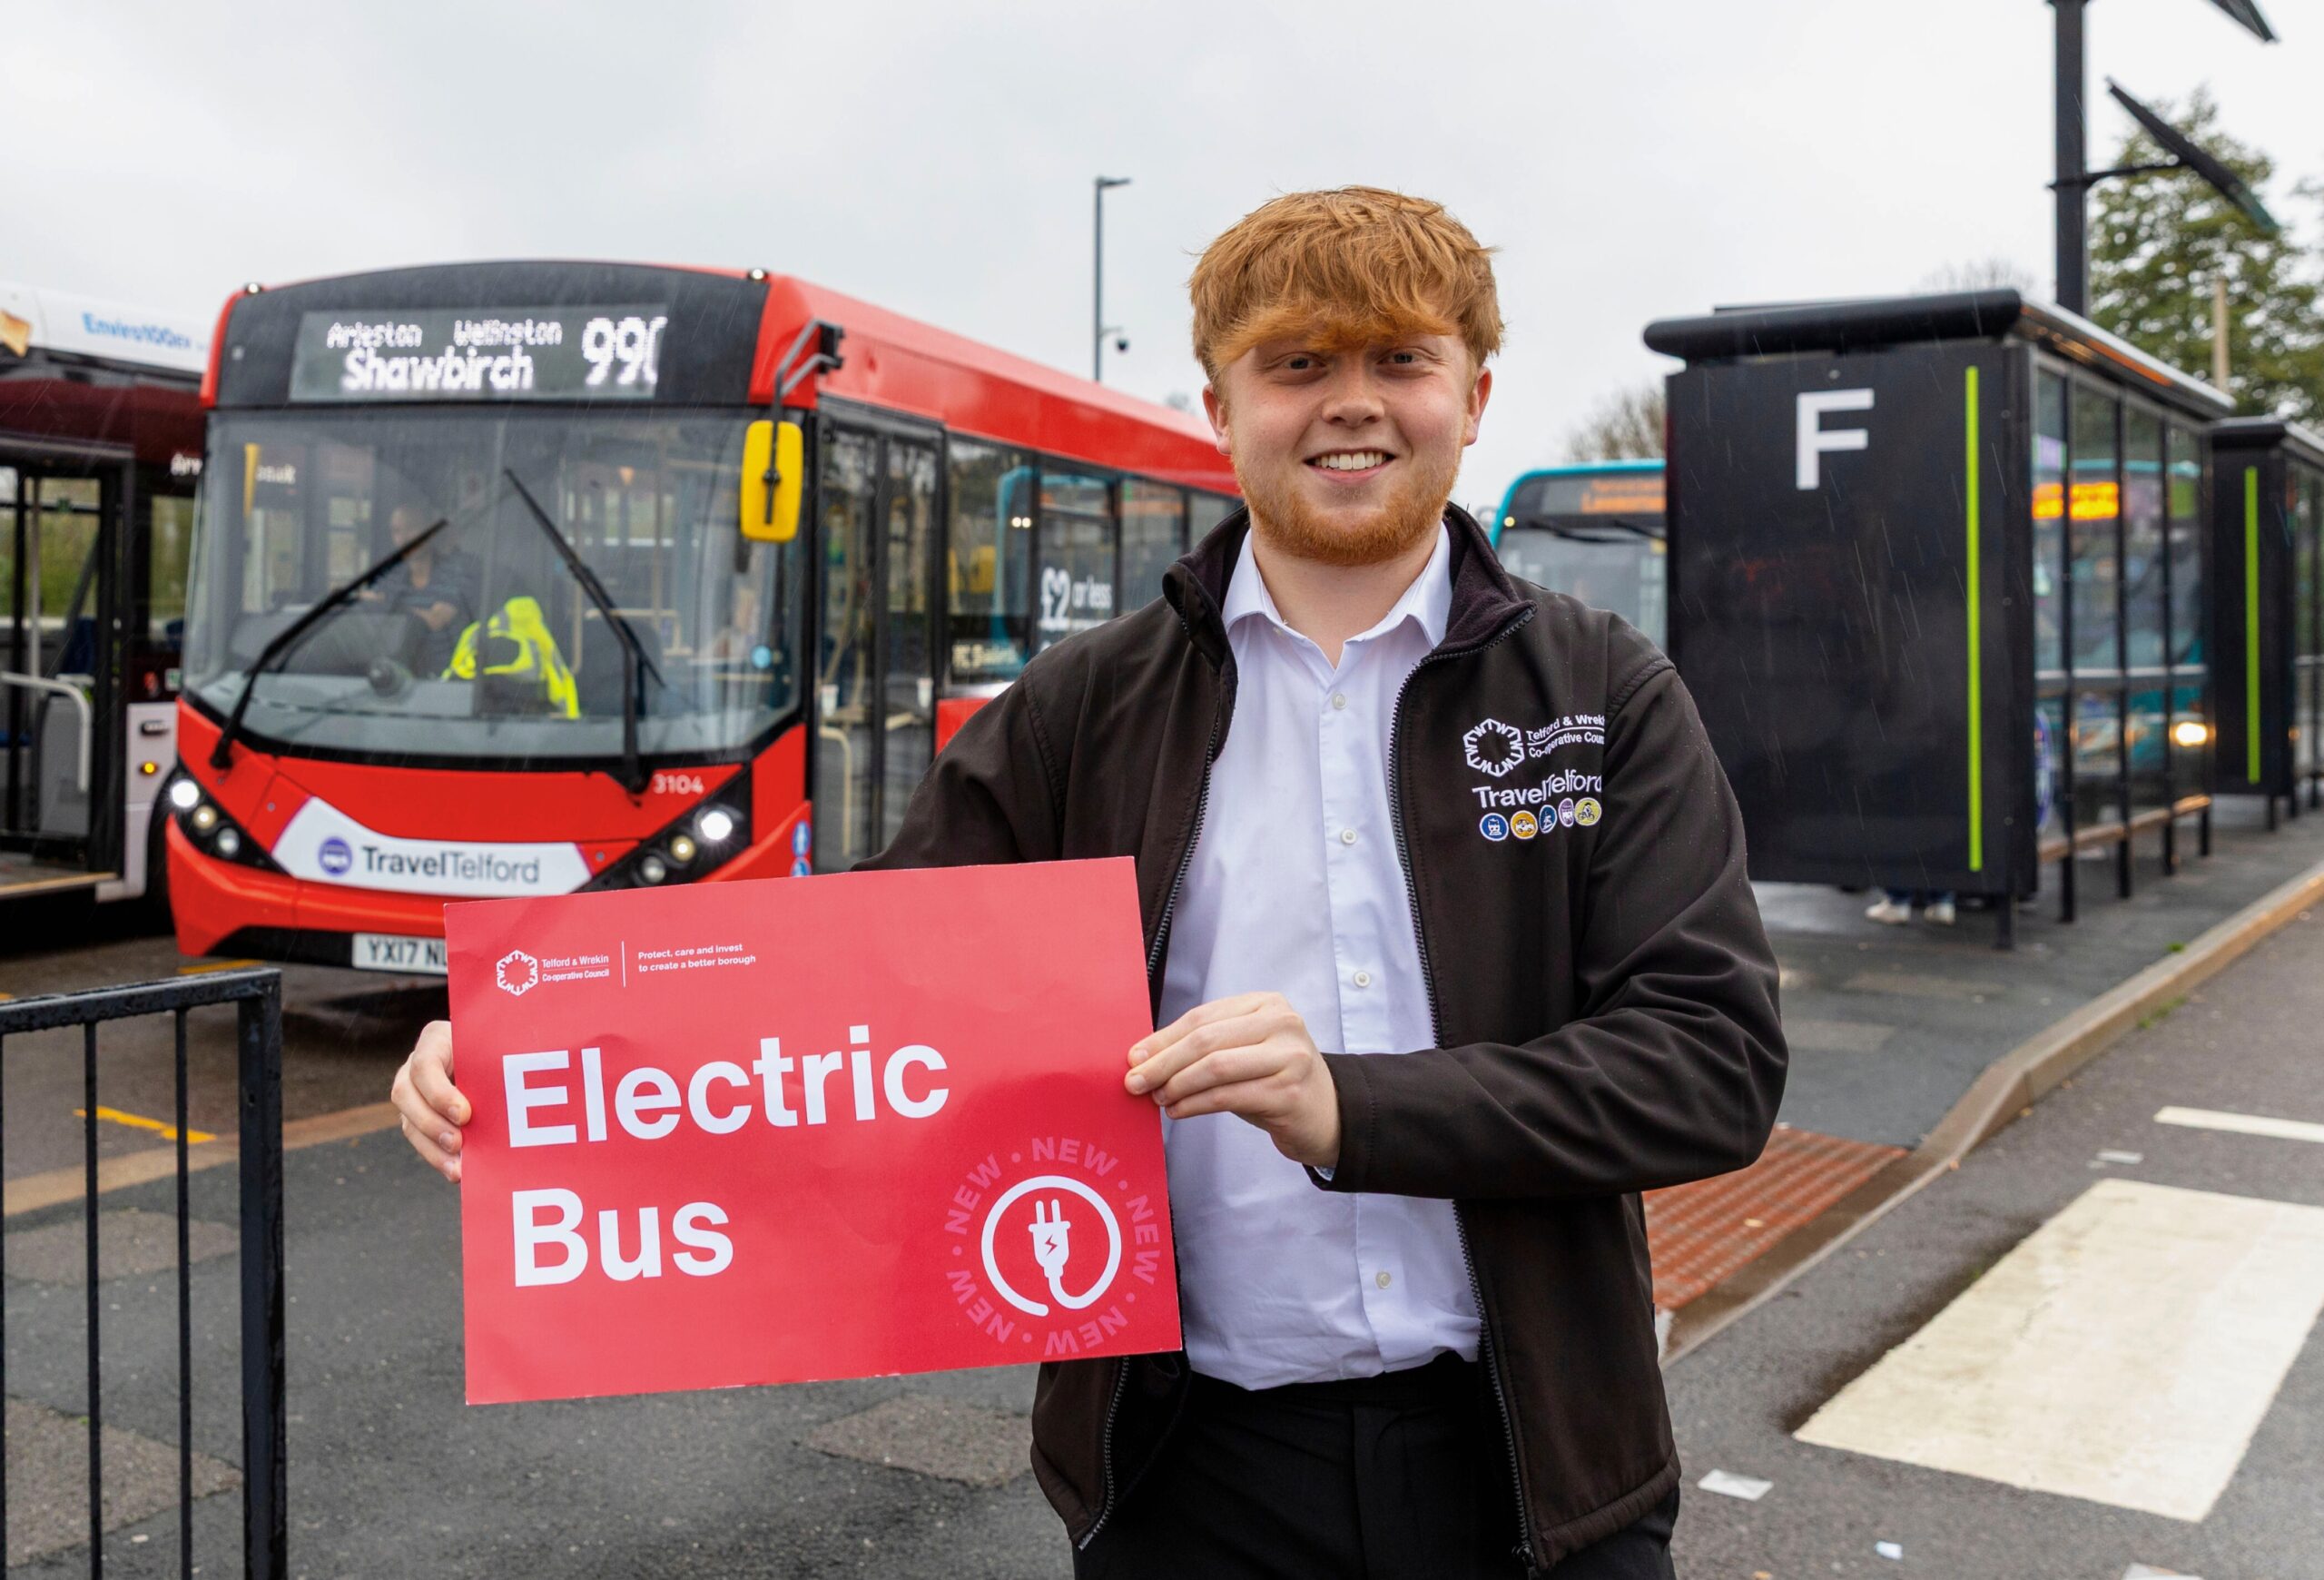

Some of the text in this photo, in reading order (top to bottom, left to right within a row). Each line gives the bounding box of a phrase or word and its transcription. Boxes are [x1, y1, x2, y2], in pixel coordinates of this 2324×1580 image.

[342, 345, 535, 390] Shawbirch
[1797, 388, 1875, 490] F
[1526, 717, 1561, 742] Telford
[654, 774, 704, 795] 3104
[361, 845, 540, 884] TravelTelford
[368, 939, 419, 963] YX17
[542, 958, 570, 968] Telford
[579, 954, 609, 965] Wrekin
[638, 950, 673, 960] Protect,
[696, 945, 714, 954] and
[638, 964, 648, 973] to
[650, 962, 678, 972] create
[688, 958, 715, 968] better
[717, 954, 756, 965] borough
[542, 969, 610, 983] Co-operative Council
[502, 1024, 950, 1148] Electric
[512, 1187, 734, 1288] Bus
[944, 1137, 1161, 1356] NEW NEW NEW NEW NEW
